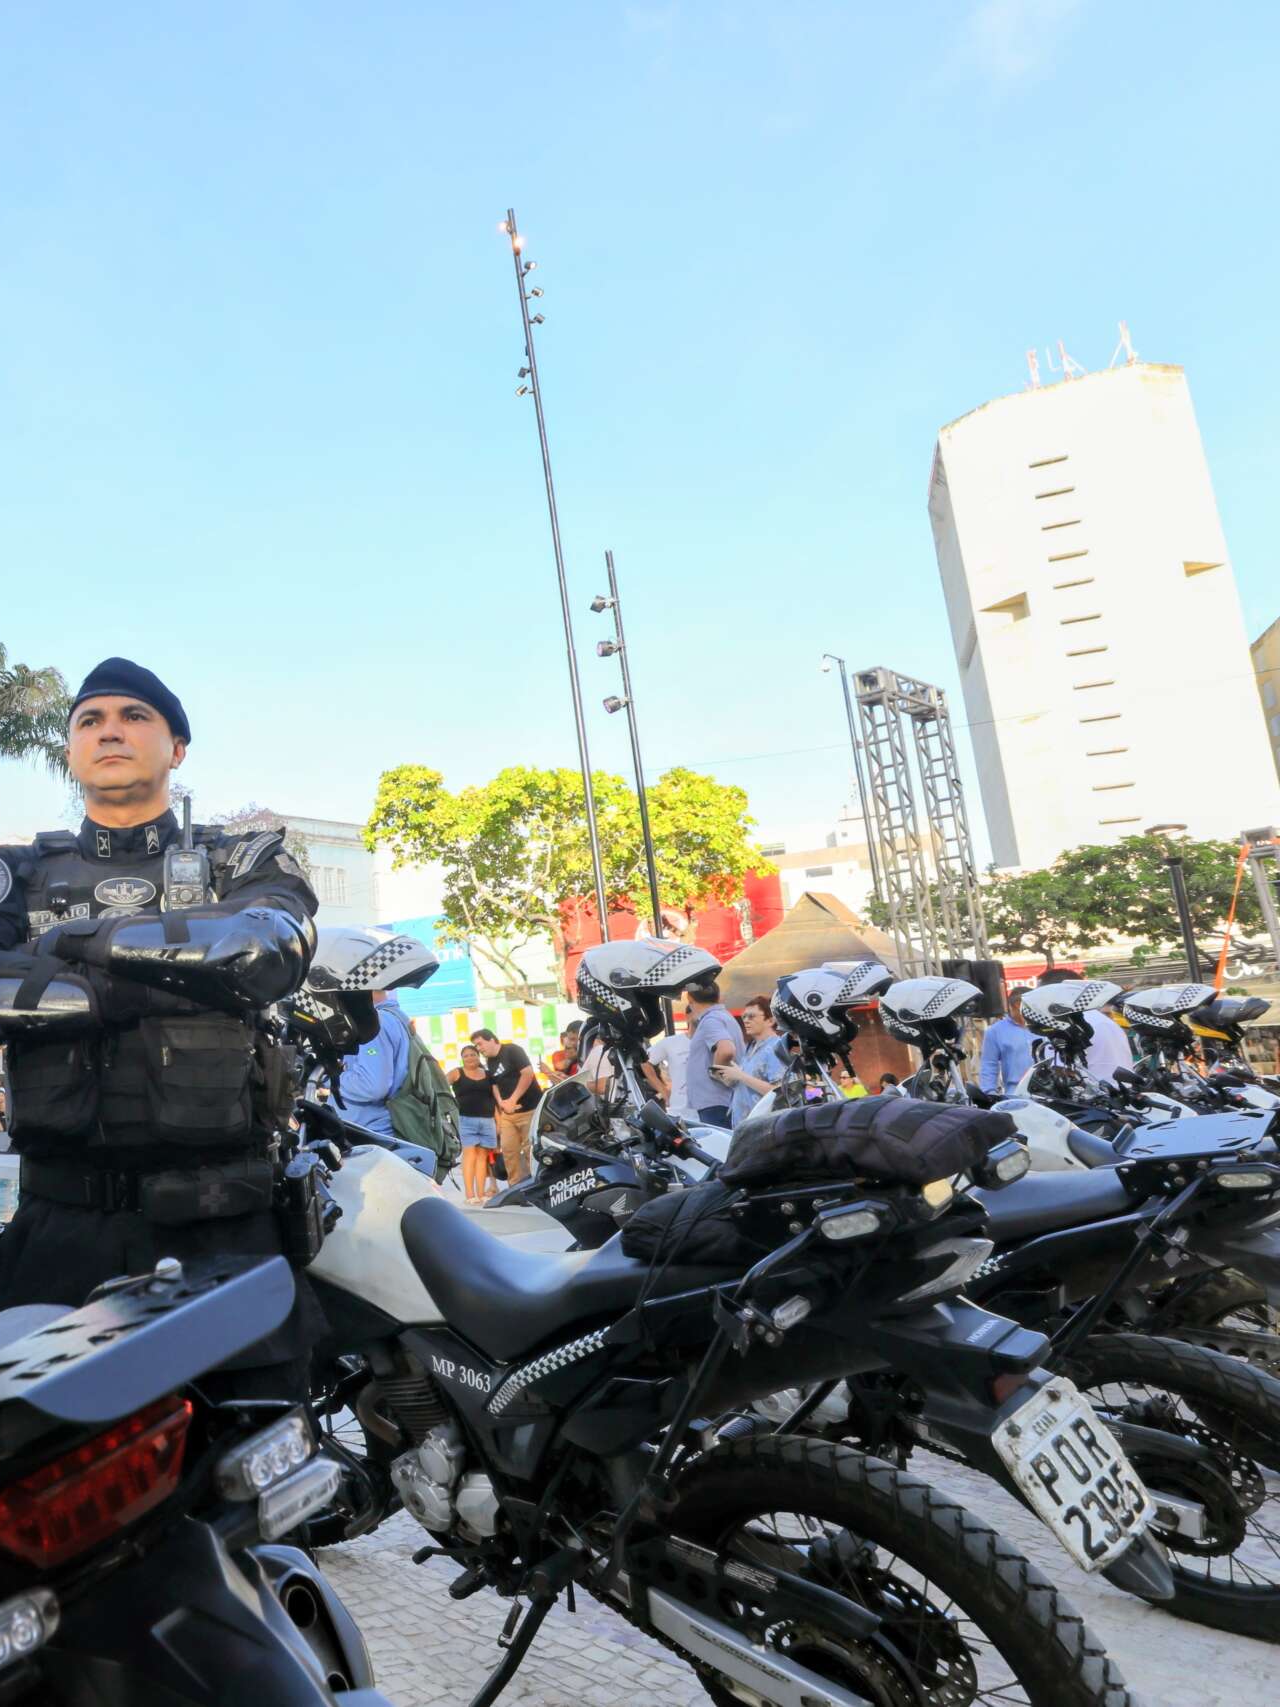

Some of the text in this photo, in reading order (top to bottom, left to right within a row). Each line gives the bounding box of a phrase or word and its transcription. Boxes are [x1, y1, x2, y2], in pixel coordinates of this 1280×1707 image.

[550, 1178, 596, 1208] MILITAR
[431, 1354, 491, 1393] MP 3063
[1030, 1417, 1111, 1507] POR
